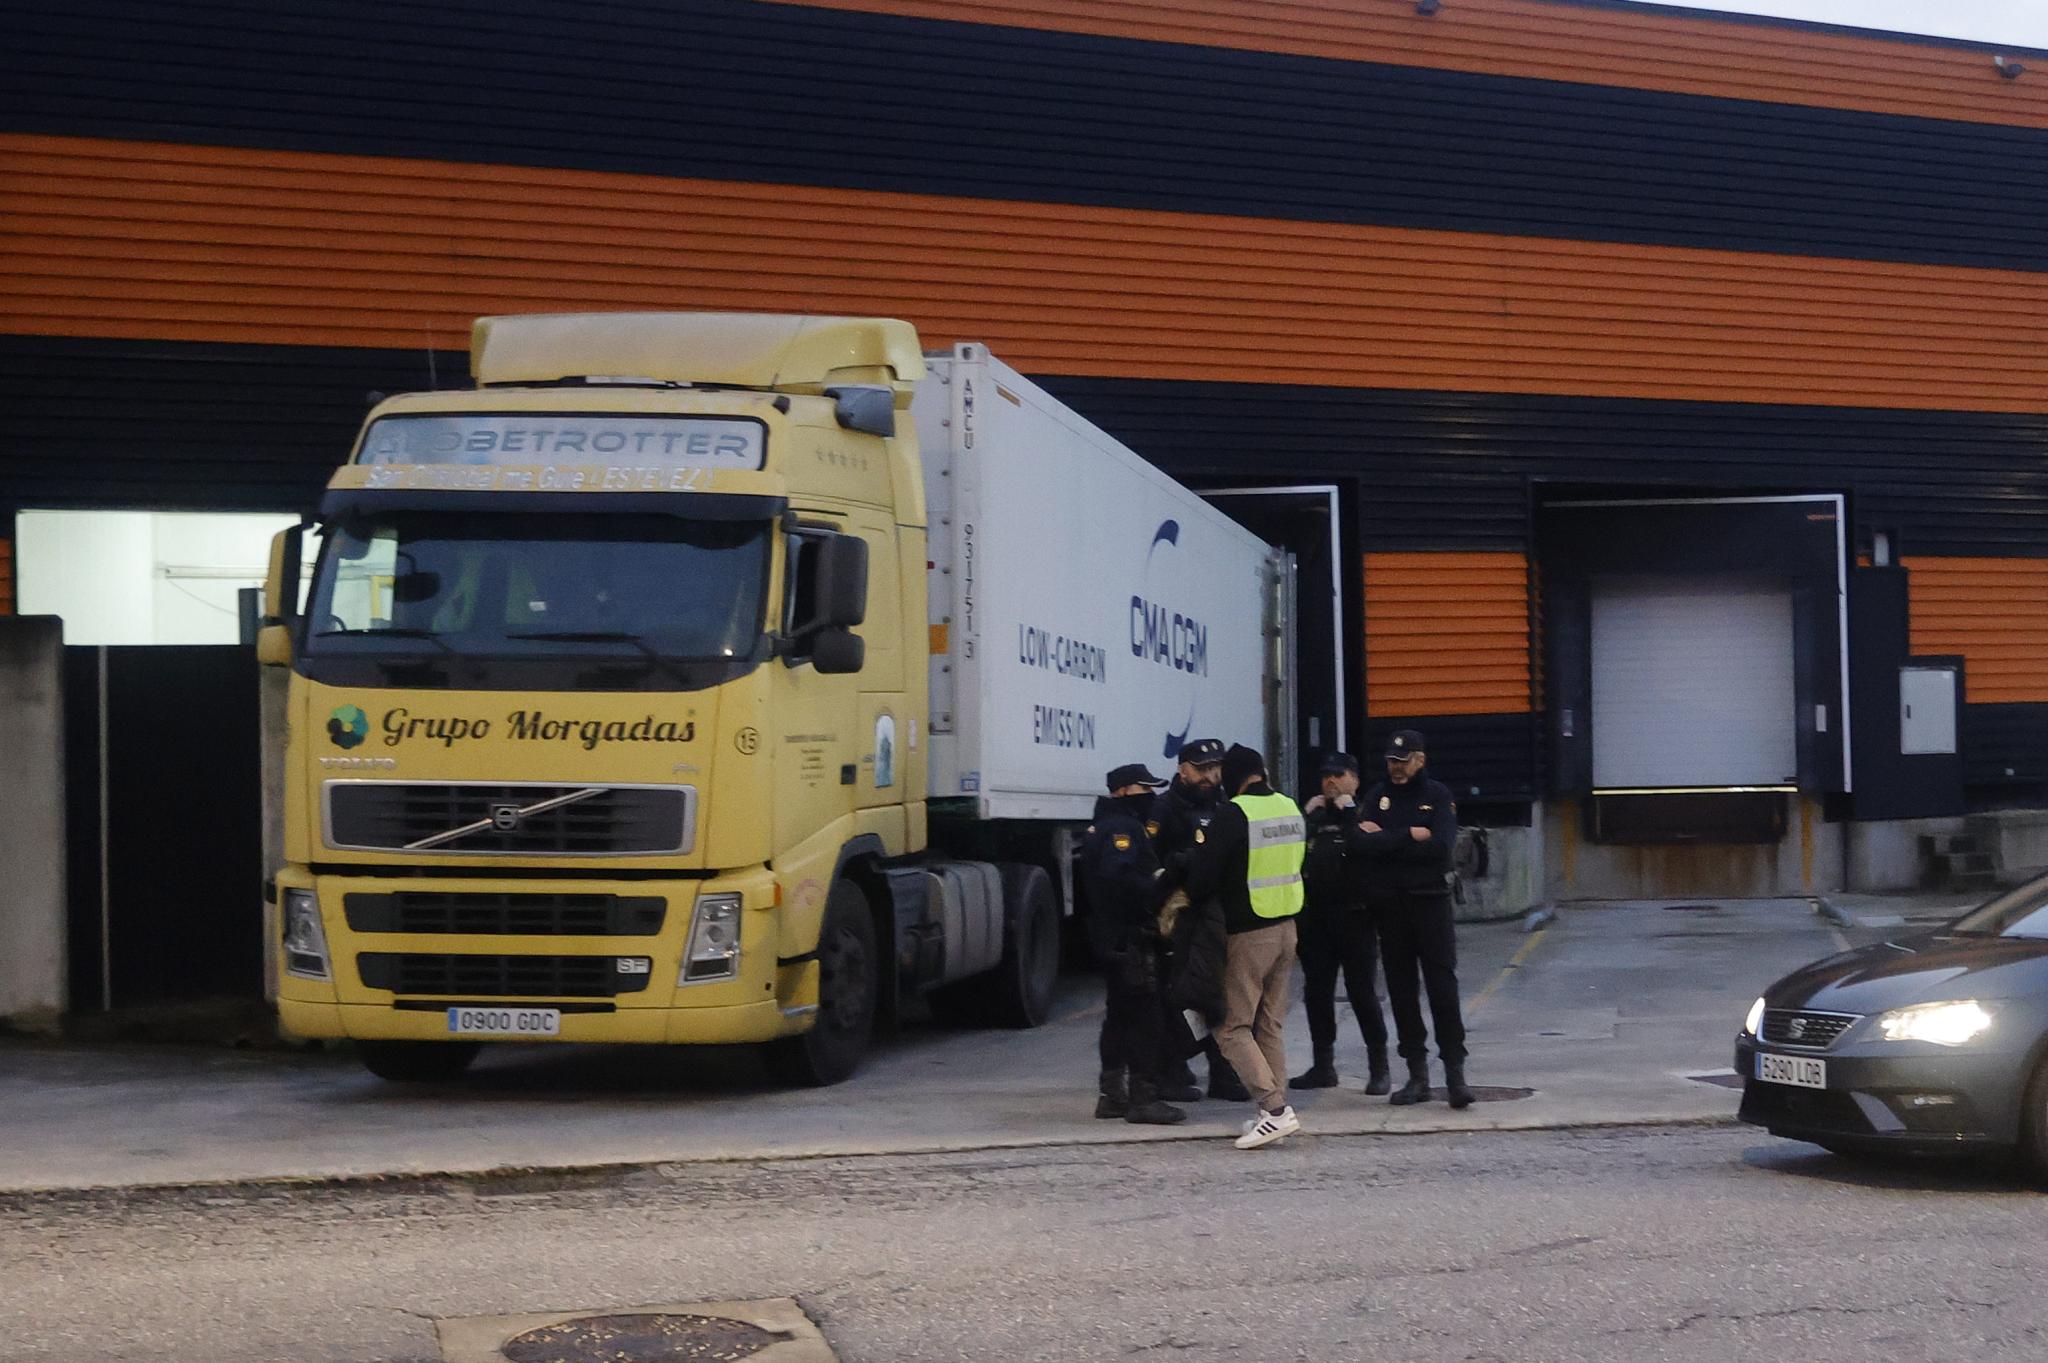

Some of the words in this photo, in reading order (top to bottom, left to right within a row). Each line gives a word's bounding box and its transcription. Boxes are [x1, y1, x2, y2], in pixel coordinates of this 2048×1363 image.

[1019, 623, 1106, 684] LOW-CARBON
[383, 707, 490, 748] Grupo
[507, 710, 695, 751] Morgadas
[1033, 704, 1095, 750] EMISSION
[462, 1011, 511, 1030] 0900
[517, 1012, 554, 1031] GDC
[1764, 1056, 1793, 1081] 5290
[1796, 1061, 1822, 1085] LDB
